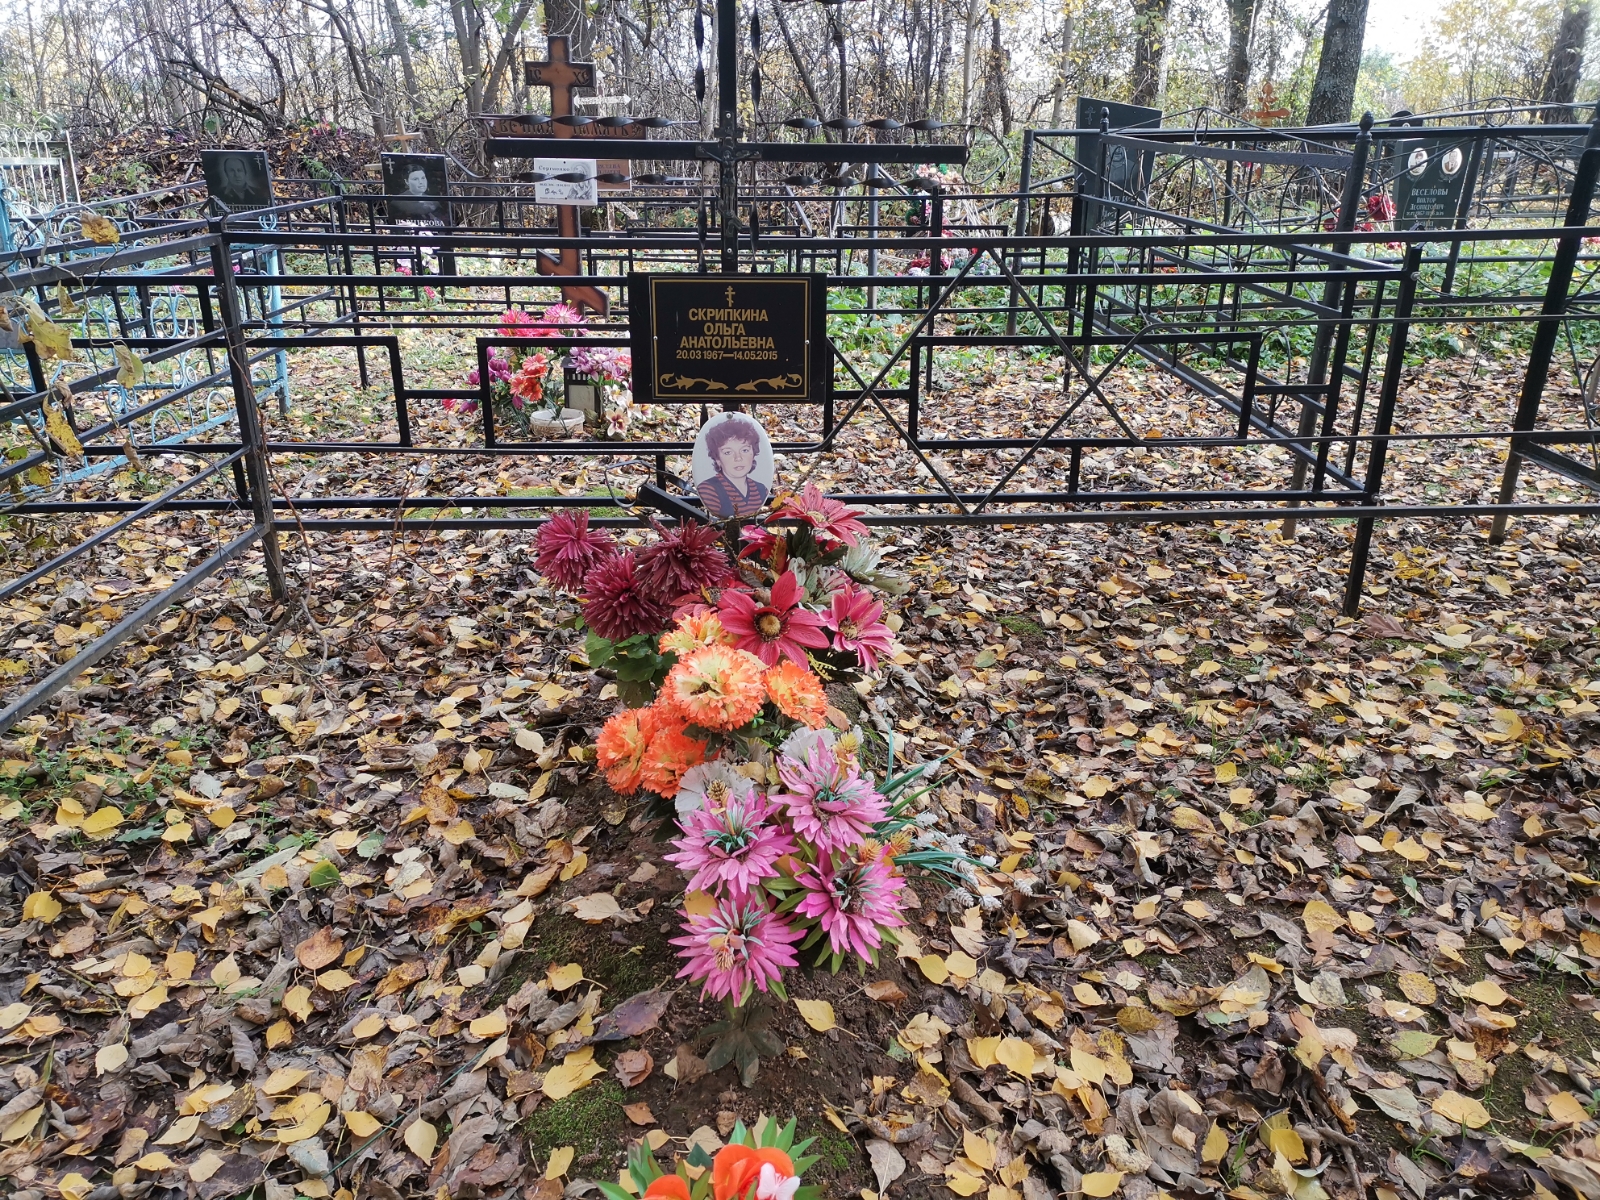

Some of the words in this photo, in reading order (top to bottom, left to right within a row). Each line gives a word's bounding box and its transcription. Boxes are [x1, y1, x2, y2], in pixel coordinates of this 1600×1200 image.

[688, 308, 769, 321] СКРИПКИНА
[703, 322, 746, 336] ОЛЬГА
[680, 336, 775, 349] АНАТОЛЬЕВНА
